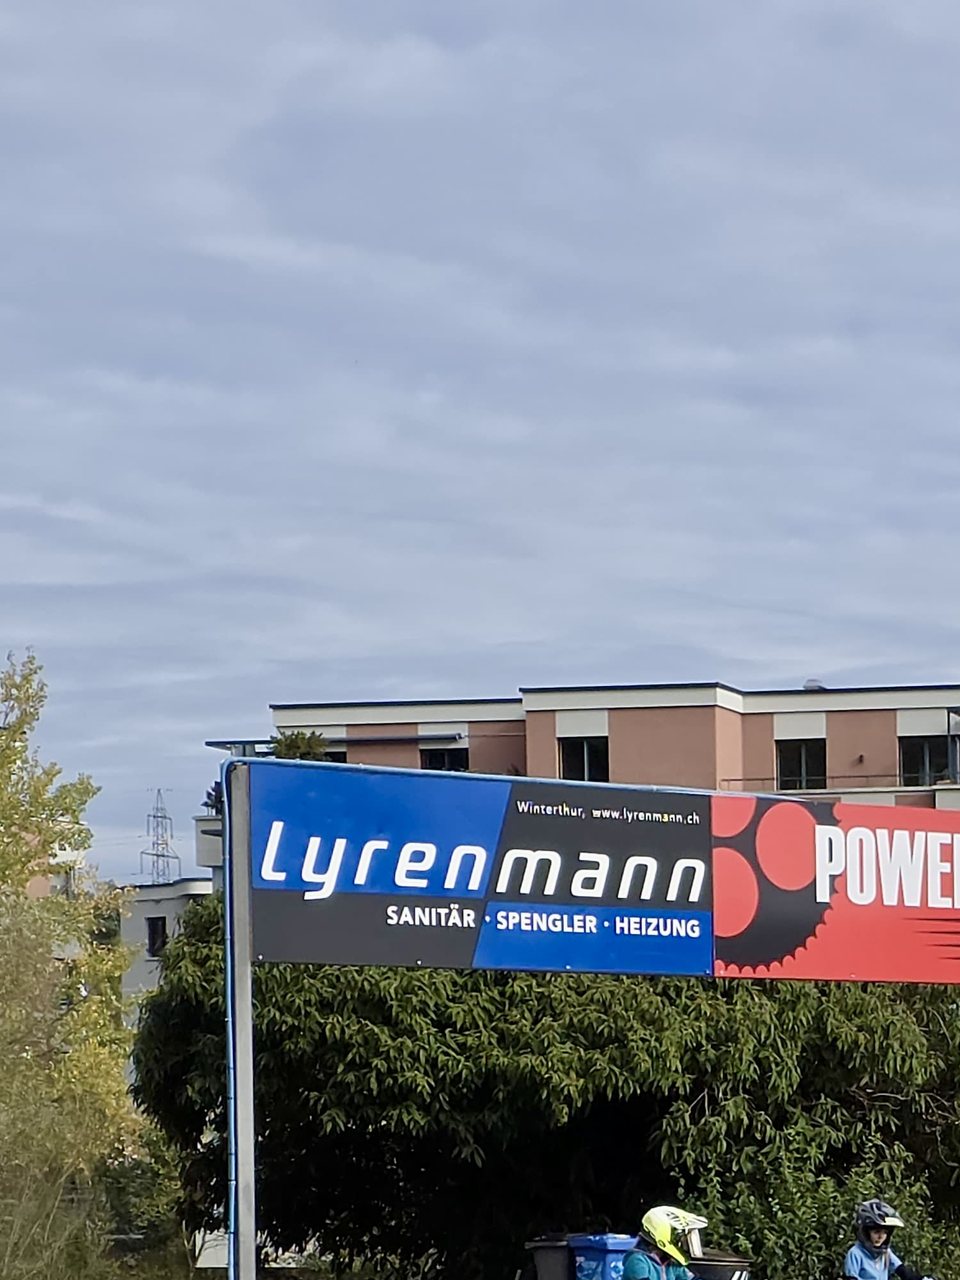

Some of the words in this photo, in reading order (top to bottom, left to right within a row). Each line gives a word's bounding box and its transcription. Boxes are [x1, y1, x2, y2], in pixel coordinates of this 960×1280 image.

[516, 800, 586, 819] Winterthur,
[592, 807, 701, 825] www.lyrenmann.ch
[386, 904, 476, 929] SANITÄR
[496, 911, 598, 935] SPENGLER
[615, 918, 701, 939] HEIZUNG
